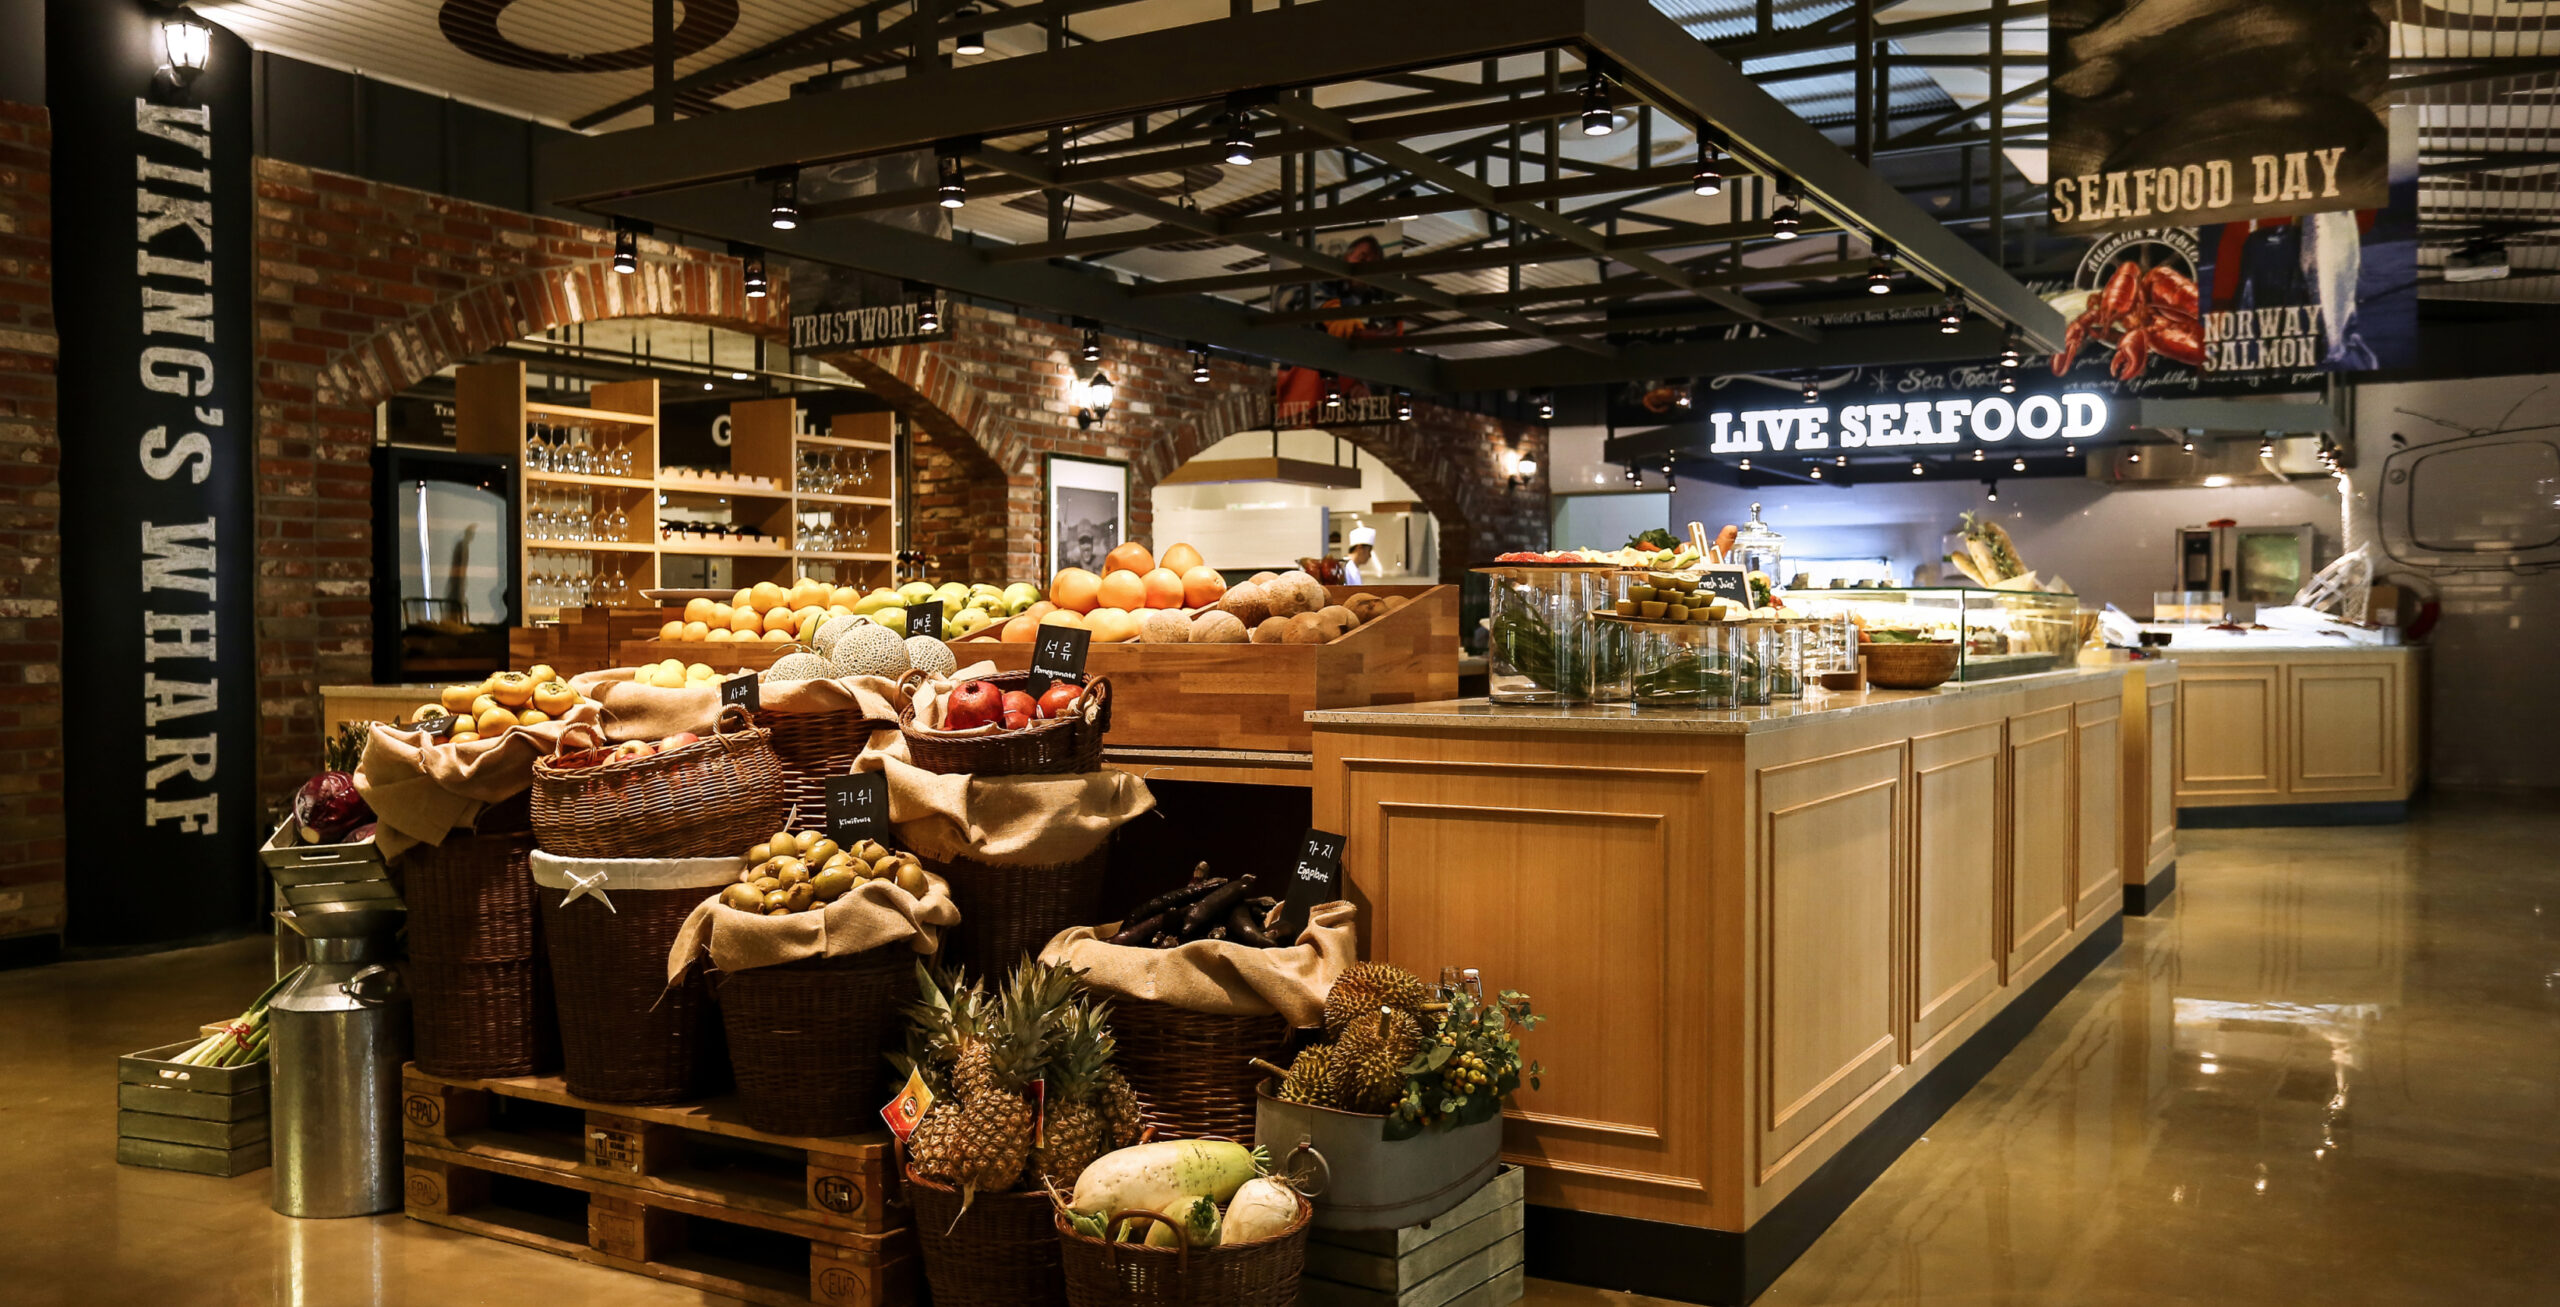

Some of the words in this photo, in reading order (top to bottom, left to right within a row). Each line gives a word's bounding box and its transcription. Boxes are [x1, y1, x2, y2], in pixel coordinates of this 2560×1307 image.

[2052, 159, 2233, 223] SEAFOOD
[2251, 147, 2346, 204] DAY
[136, 97, 224, 484] VIKING'S
[792, 299, 948, 349] TRUSTWORTY
[2202, 304, 2323, 342] NORWAY
[2201, 336, 2317, 373] SALMON
[1896, 367, 1946, 393] Sea
[1273, 401, 1311, 426] LIVE
[1316, 396, 1391, 424] LOBSTER
[1710, 407, 1829, 454] LIVE
[1840, 392, 2108, 449] SEAFOOD
[913, 613, 931, 633] 메론
[1044, 640, 1072, 662] 석류
[142, 516, 218, 834] WHARF
[837, 788, 872, 807] 키위
[1309, 840, 1334, 859] 가지
[828, 1272, 856, 1298] EUR
